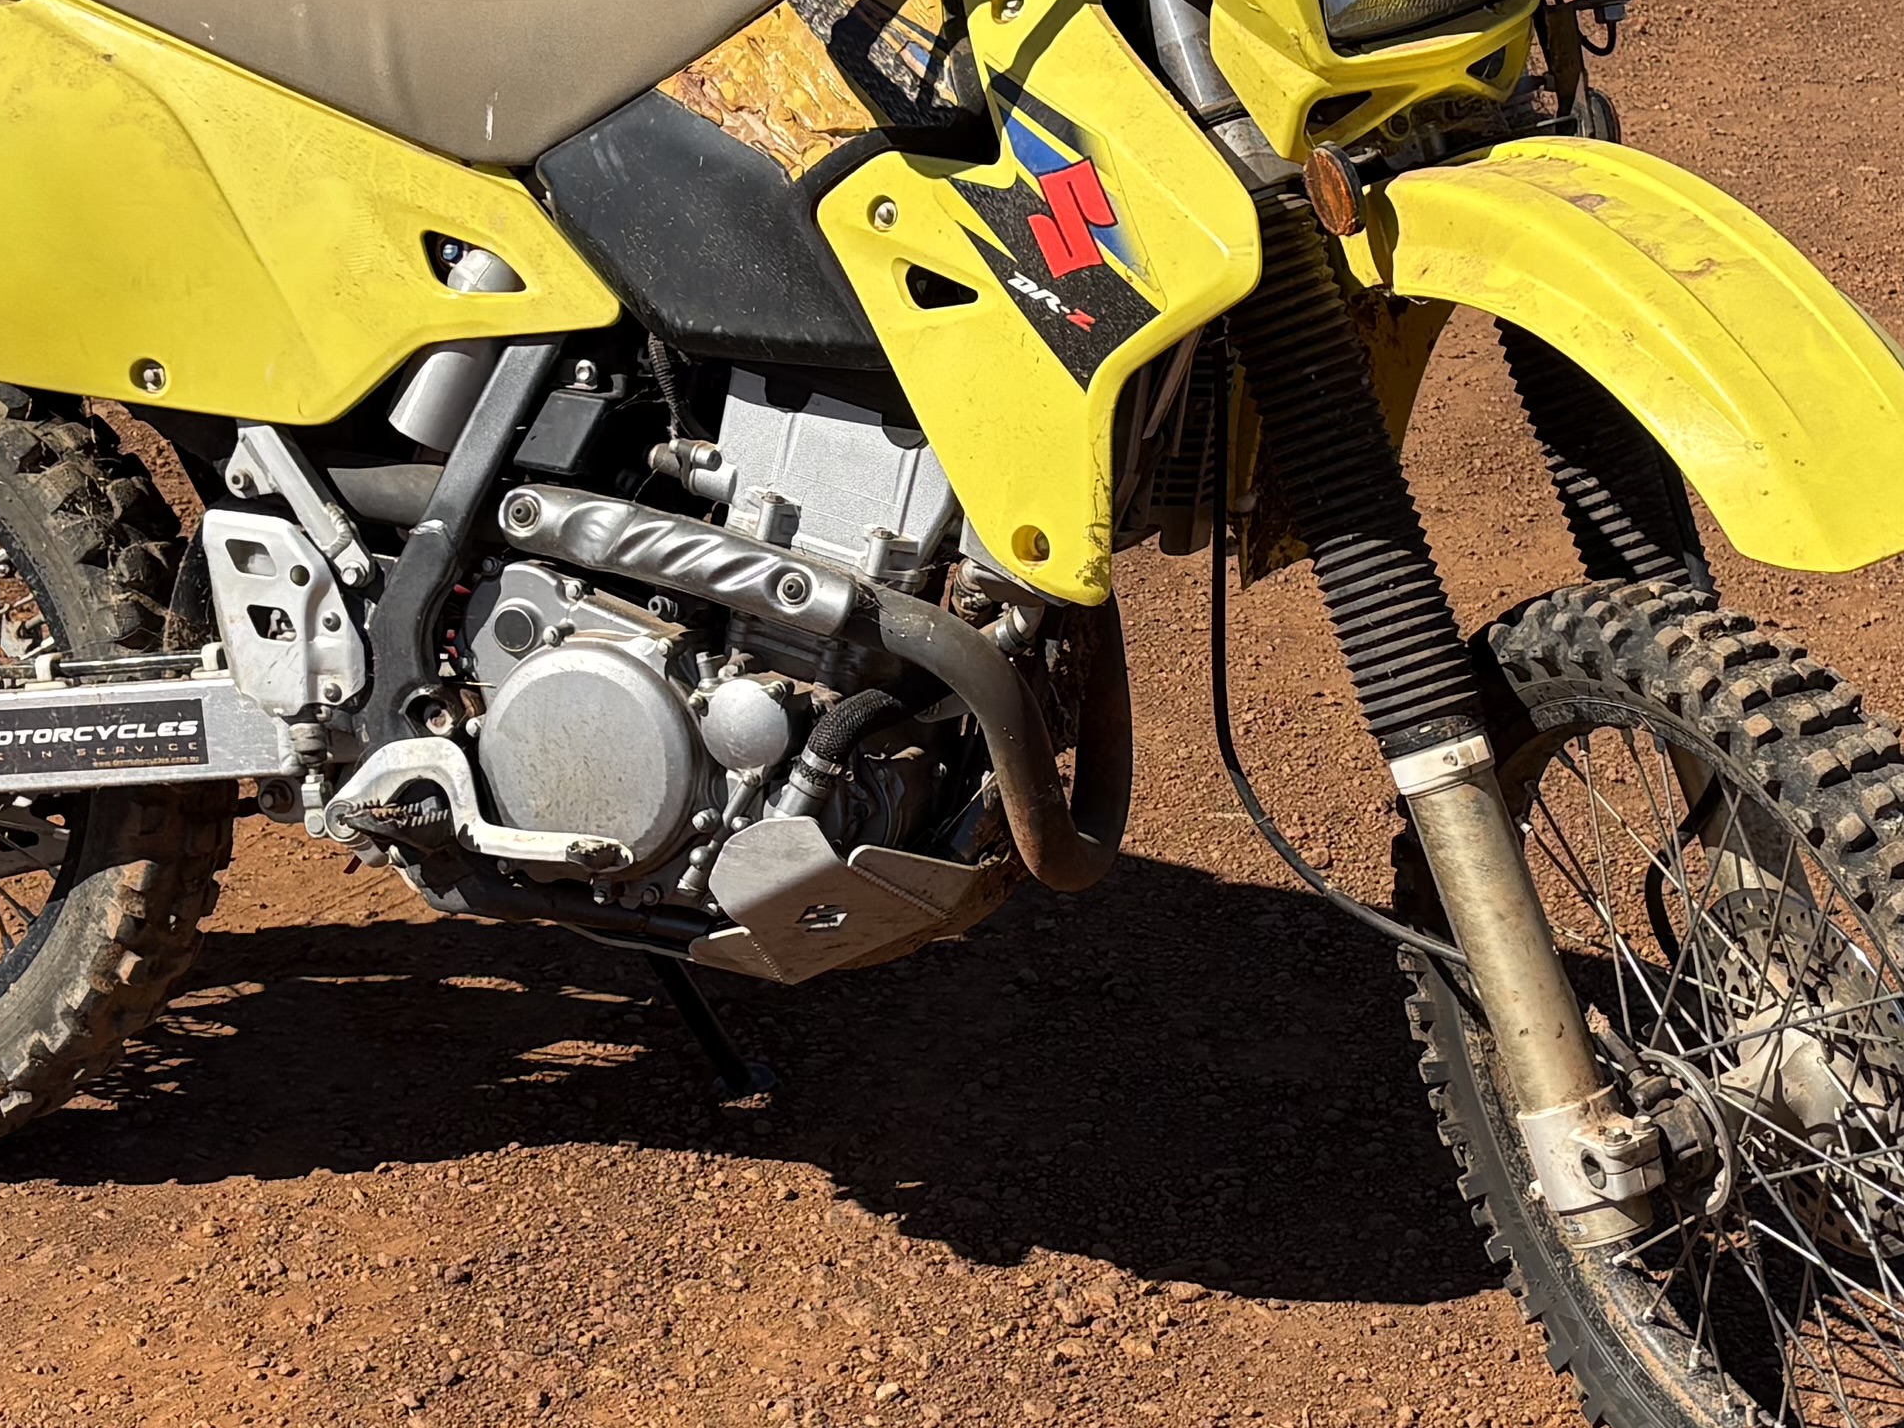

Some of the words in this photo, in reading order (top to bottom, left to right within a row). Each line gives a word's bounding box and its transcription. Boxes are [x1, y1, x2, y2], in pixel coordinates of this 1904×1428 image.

[1007, 270, 1097, 333] DR-Z
[26, 750, 52, 759] IN
[76, 742, 198, 757] SERVICE
